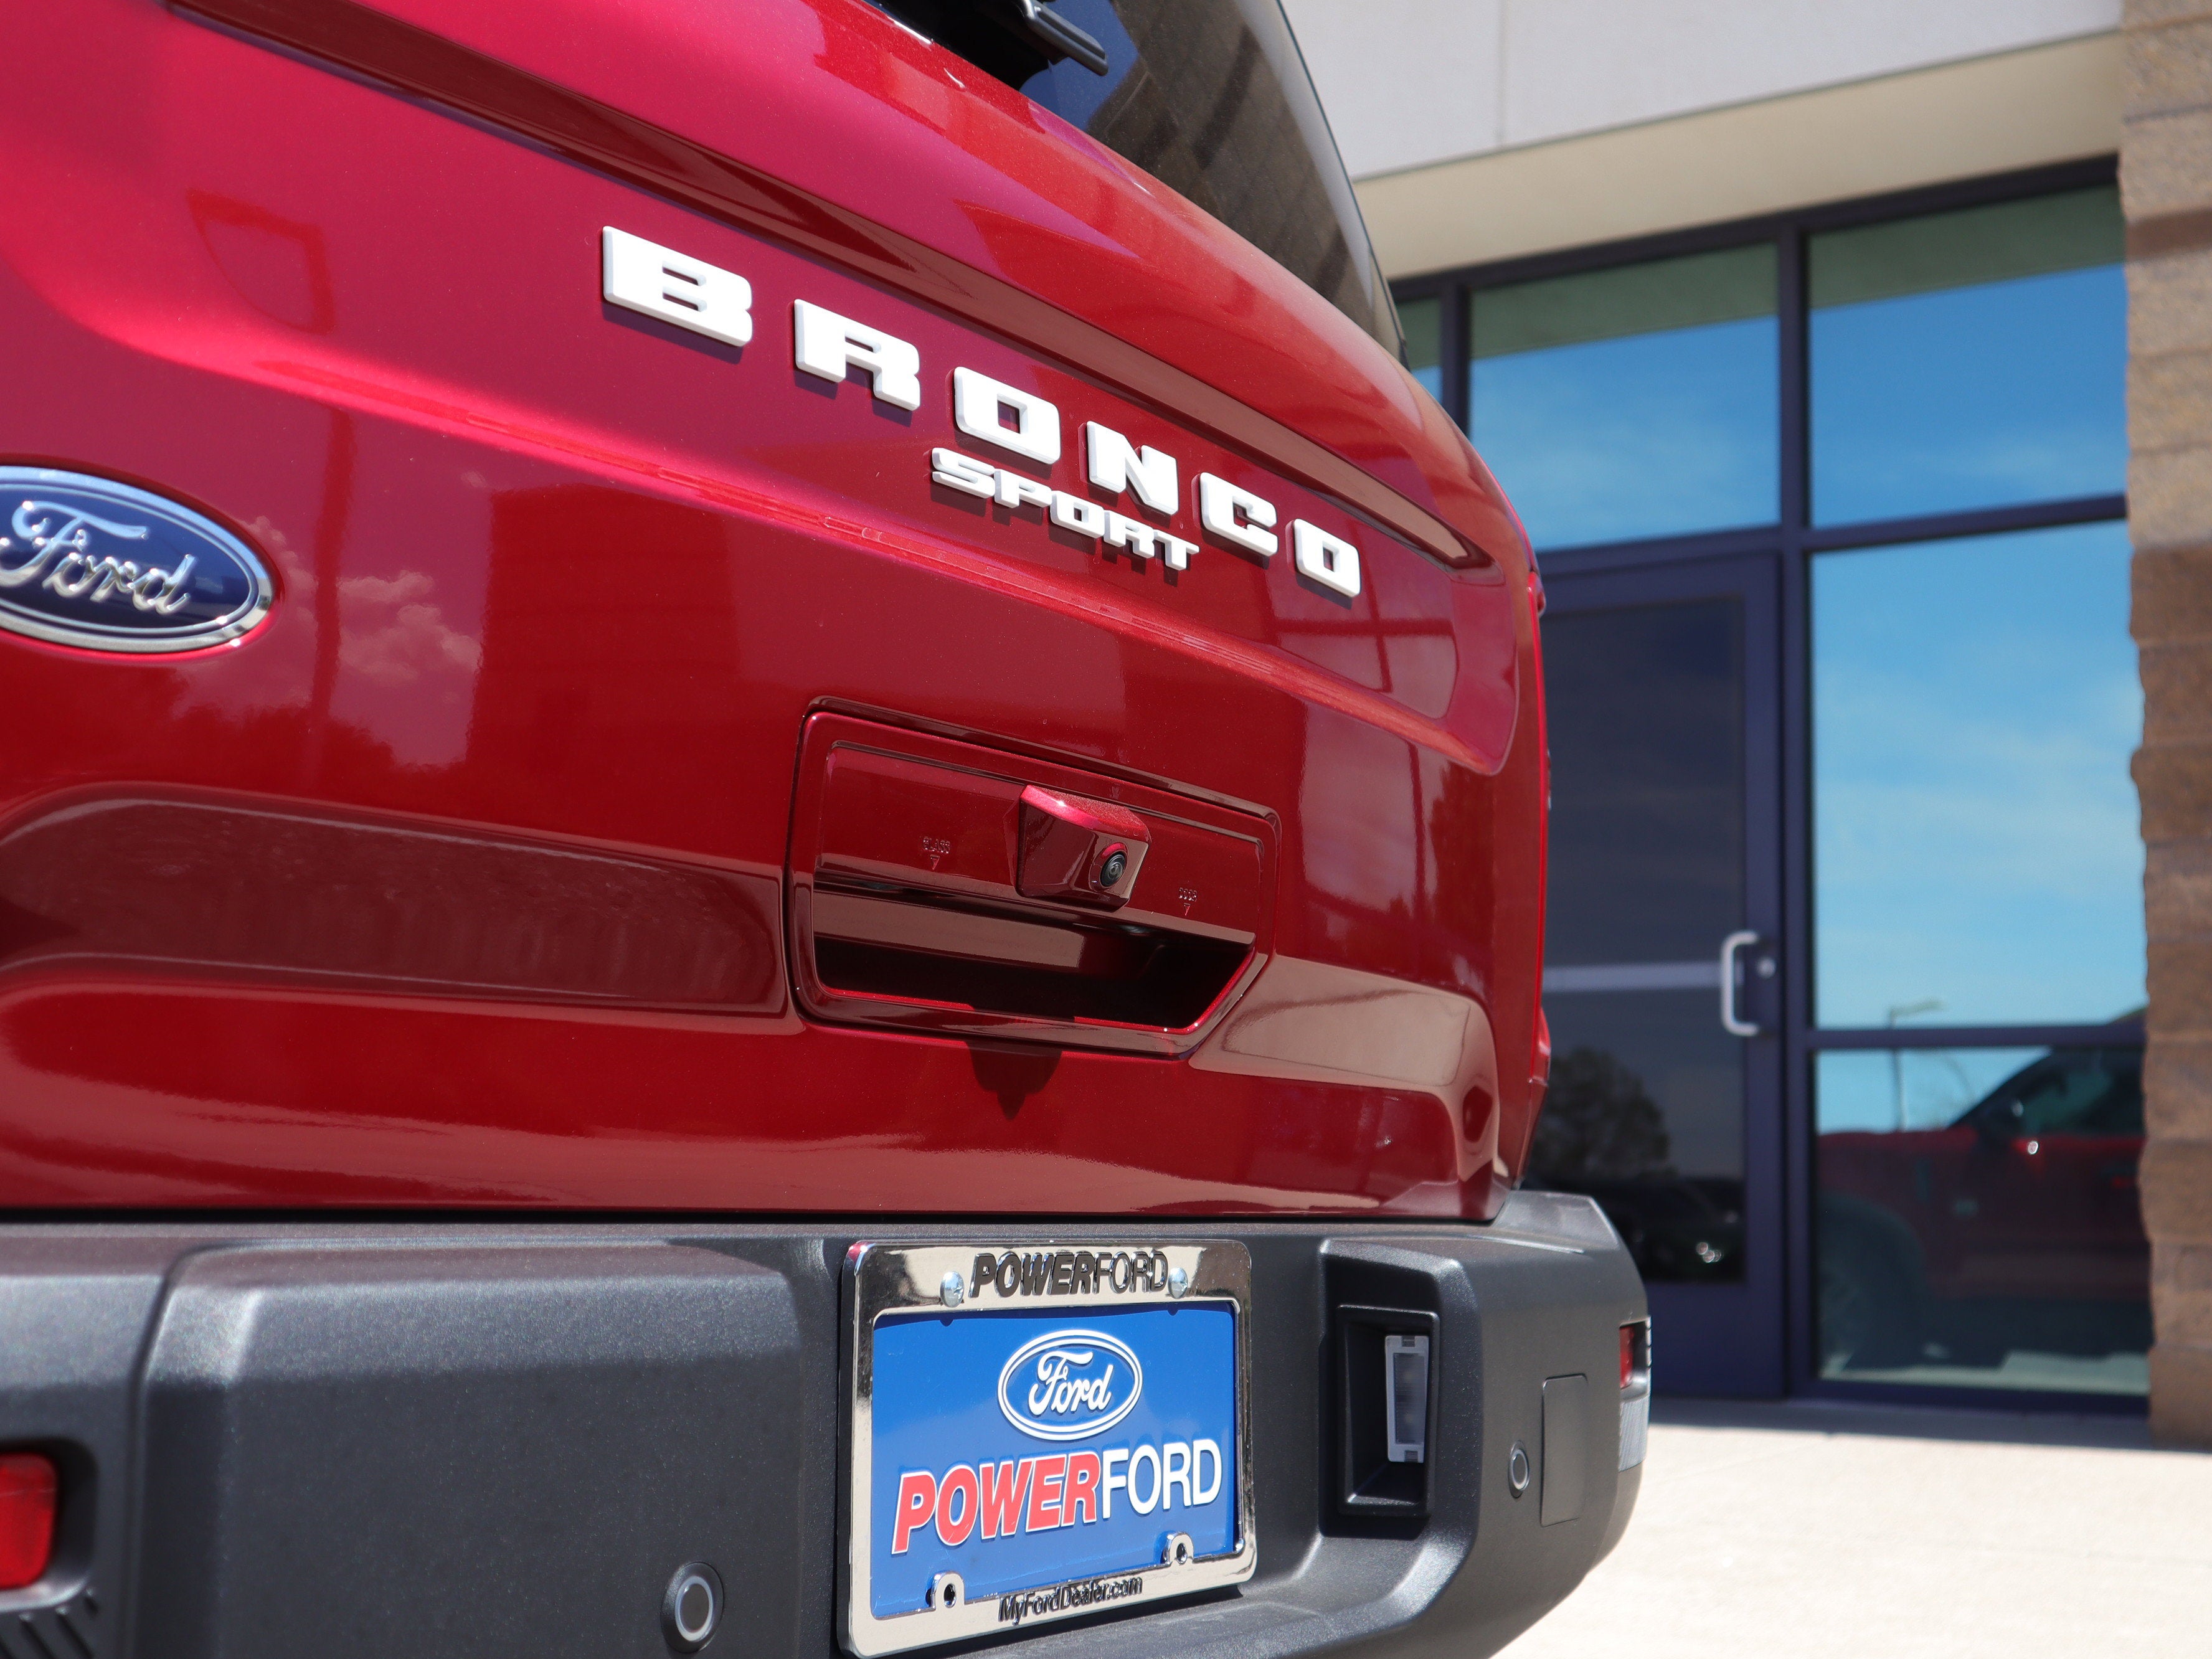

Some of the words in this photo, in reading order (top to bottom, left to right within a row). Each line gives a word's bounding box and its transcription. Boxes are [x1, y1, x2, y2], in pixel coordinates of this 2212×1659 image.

[602, 225, 1361, 598] BRONCO
[0, 500, 196, 615] Ford
[931, 447, 1200, 571] SPORT
[1028, 1351, 1113, 1416] Ford
[998, 1576, 1143, 1625] MyFordDealer.com
